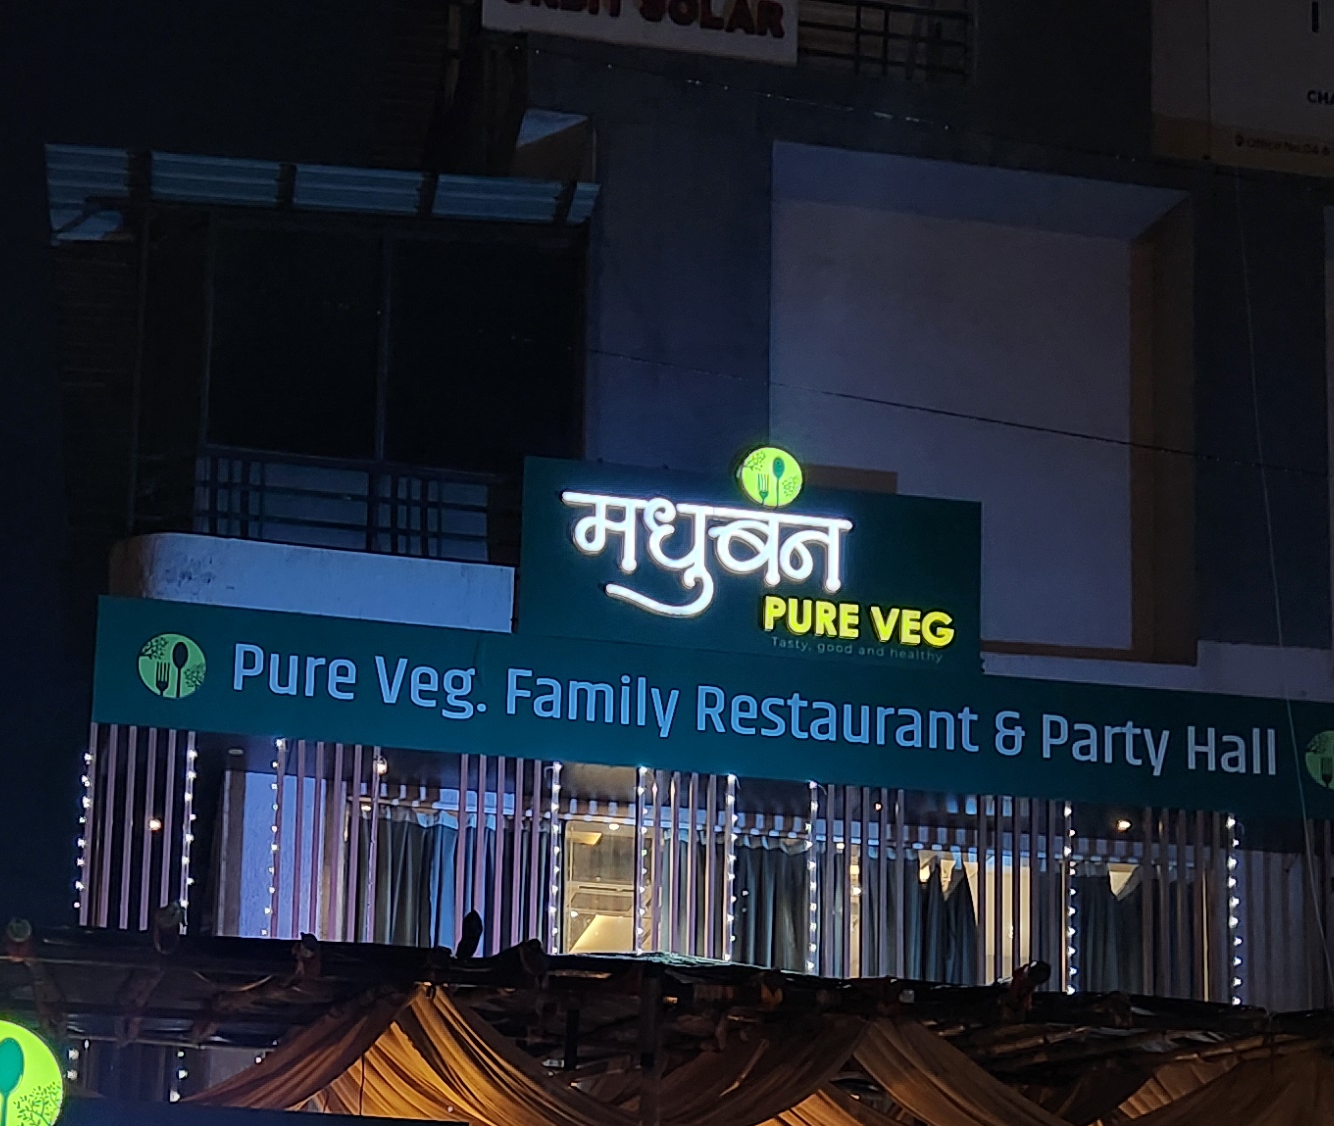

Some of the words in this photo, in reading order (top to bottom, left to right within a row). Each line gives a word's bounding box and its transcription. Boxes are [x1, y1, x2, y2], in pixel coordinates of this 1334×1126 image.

[561, 490, 853, 617] मधुबन
[763, 595, 859, 640] PURE
[870, 605, 956, 648] VEG
[772, 636, 812, 652] Tasty,
[817, 642, 853, 655] good
[858, 645, 885, 657] and
[889, 647, 944, 664] healthy
[233, 642, 355, 700] Pure
[374, 655, 486, 718] Veg.
[506, 667, 679, 738] Family
[696, 685, 979, 755] Restaurant
[995, 710, 1025, 756] &
[1042, 714, 1170, 776] Party
[1187, 726, 1277, 776] Hall
